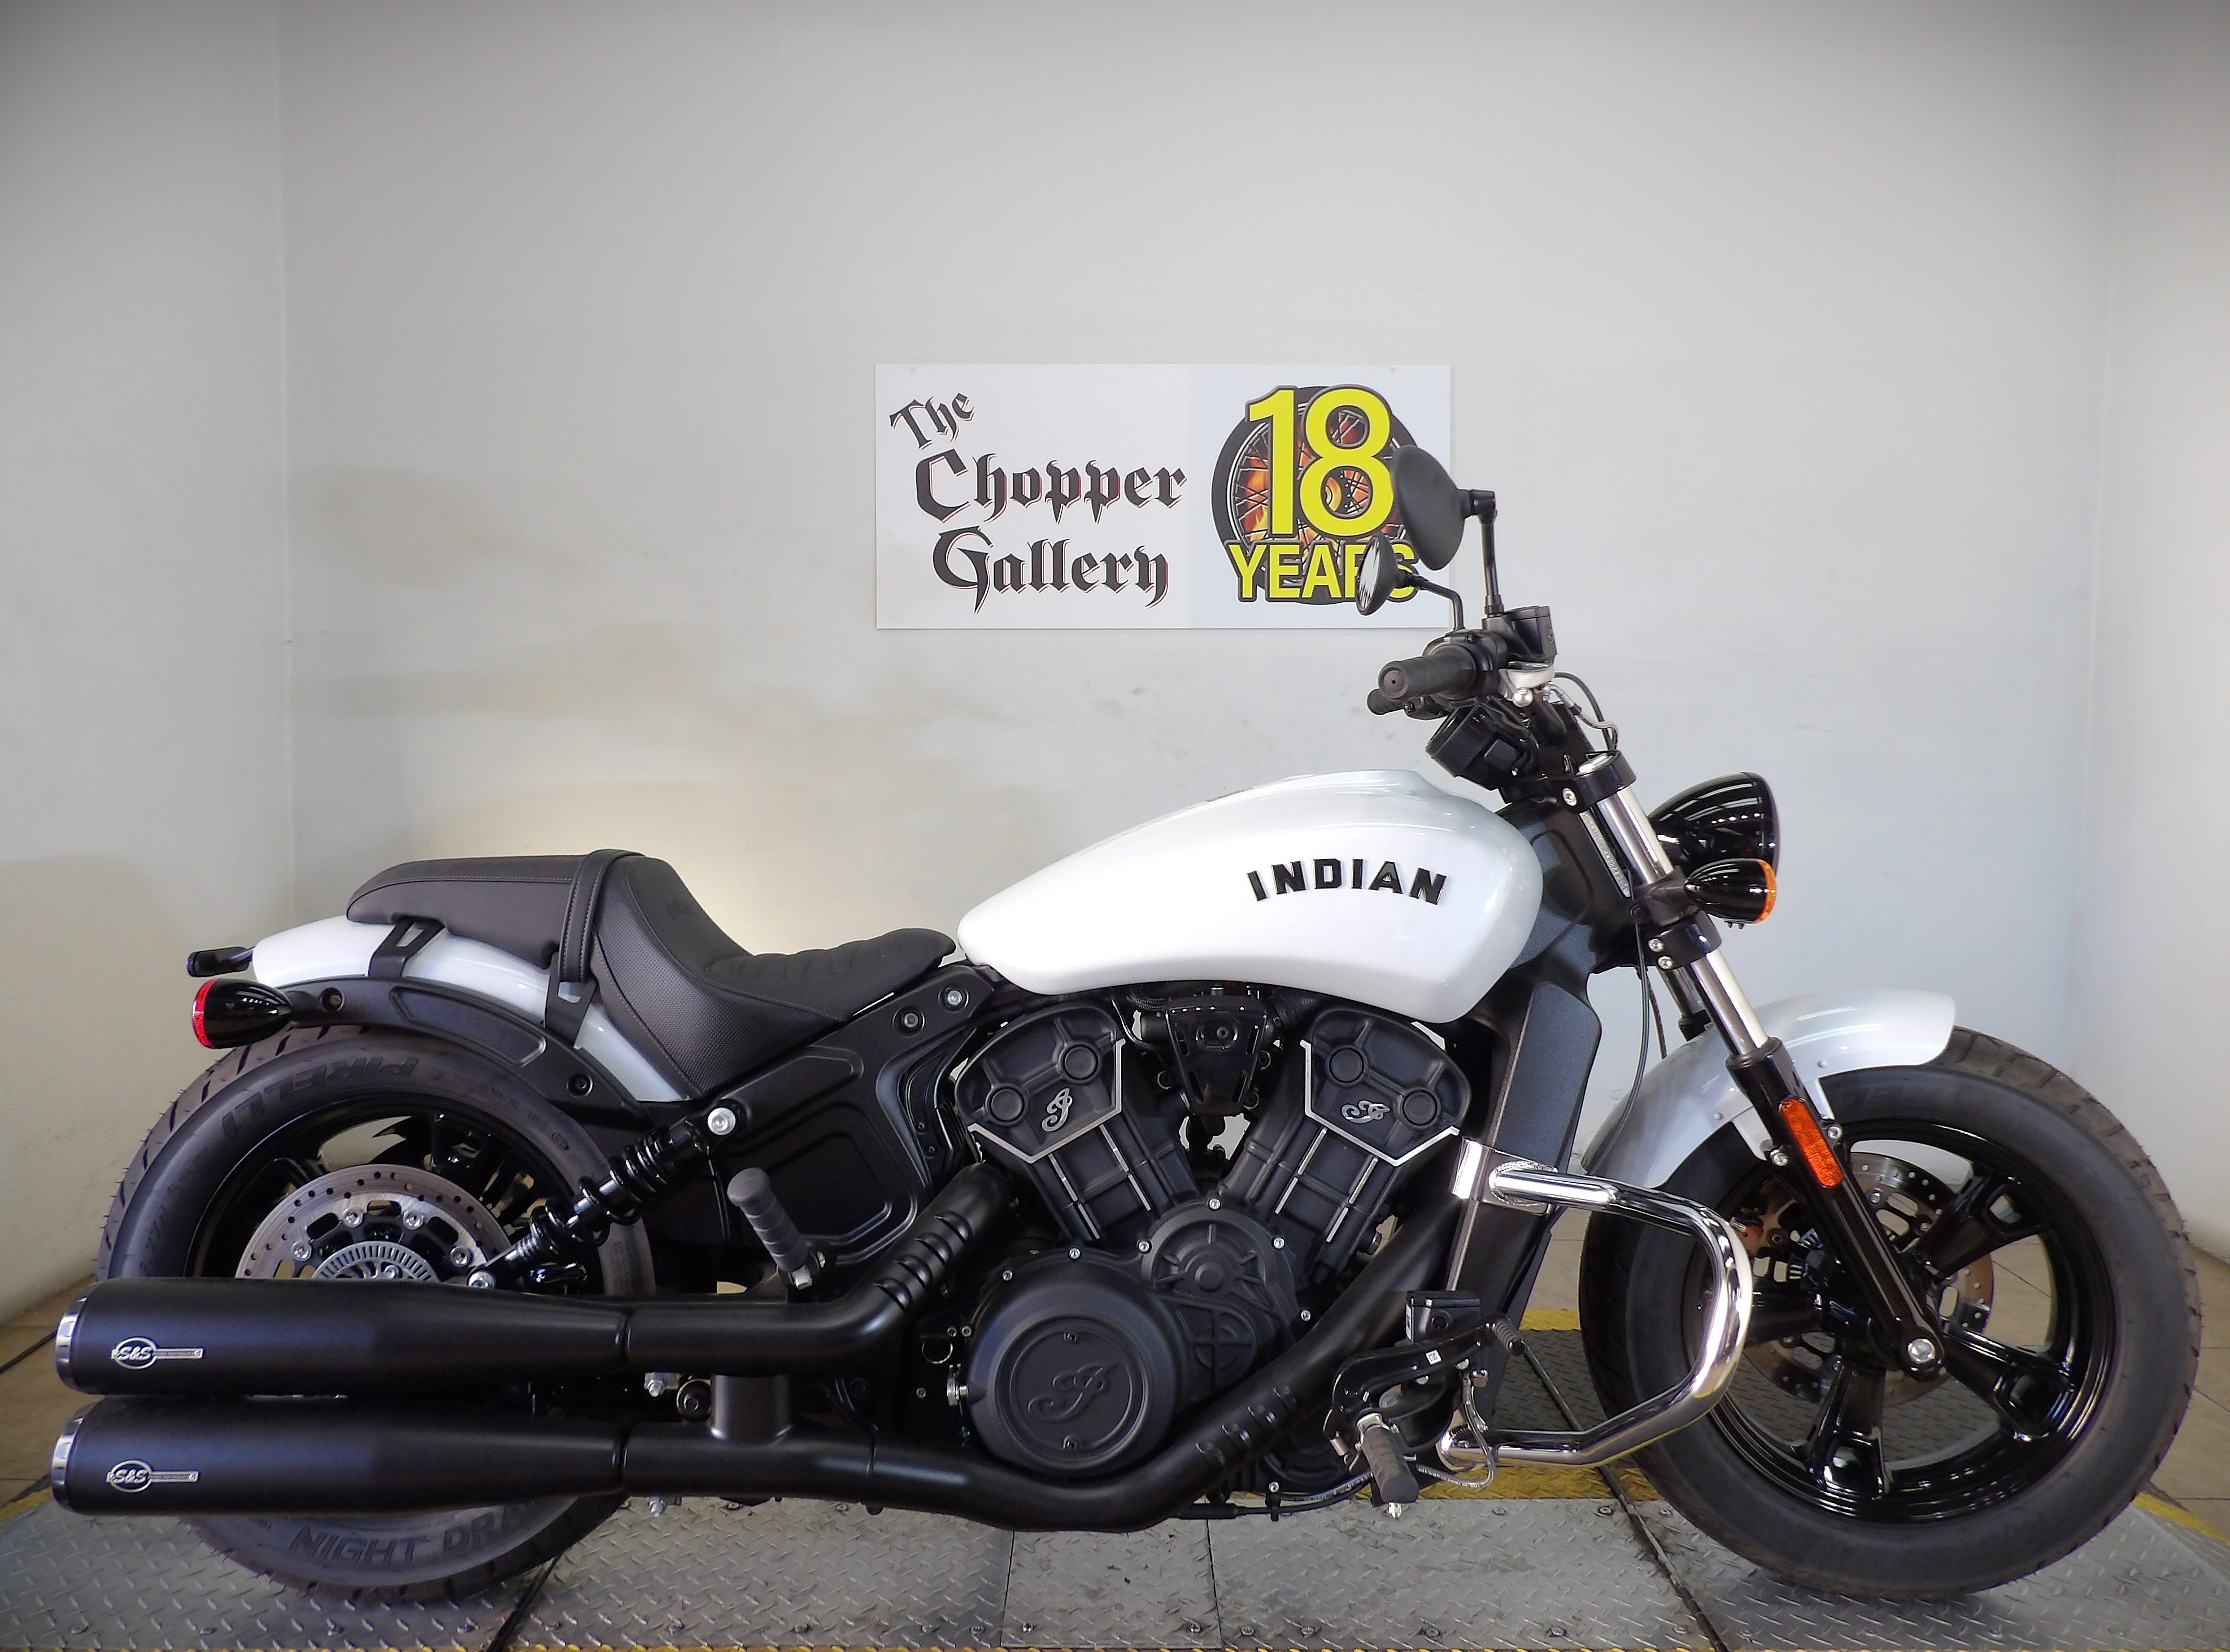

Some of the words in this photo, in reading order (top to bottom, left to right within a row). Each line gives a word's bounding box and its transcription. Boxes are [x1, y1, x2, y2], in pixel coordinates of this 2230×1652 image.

[889, 392, 974, 450] The
[915, 448, 1188, 524] Chopper
[1247, 386, 1396, 537] 18
[933, 526, 1169, 614] Gallery
[1246, 858, 1447, 905] INDIAN
[221, 1057, 420, 1138] PIRELLI
[118, 1346, 153, 1361] S&S
[113, 1469, 149, 1484] S&S
[289, 1524, 428, 1563] NIGHT
